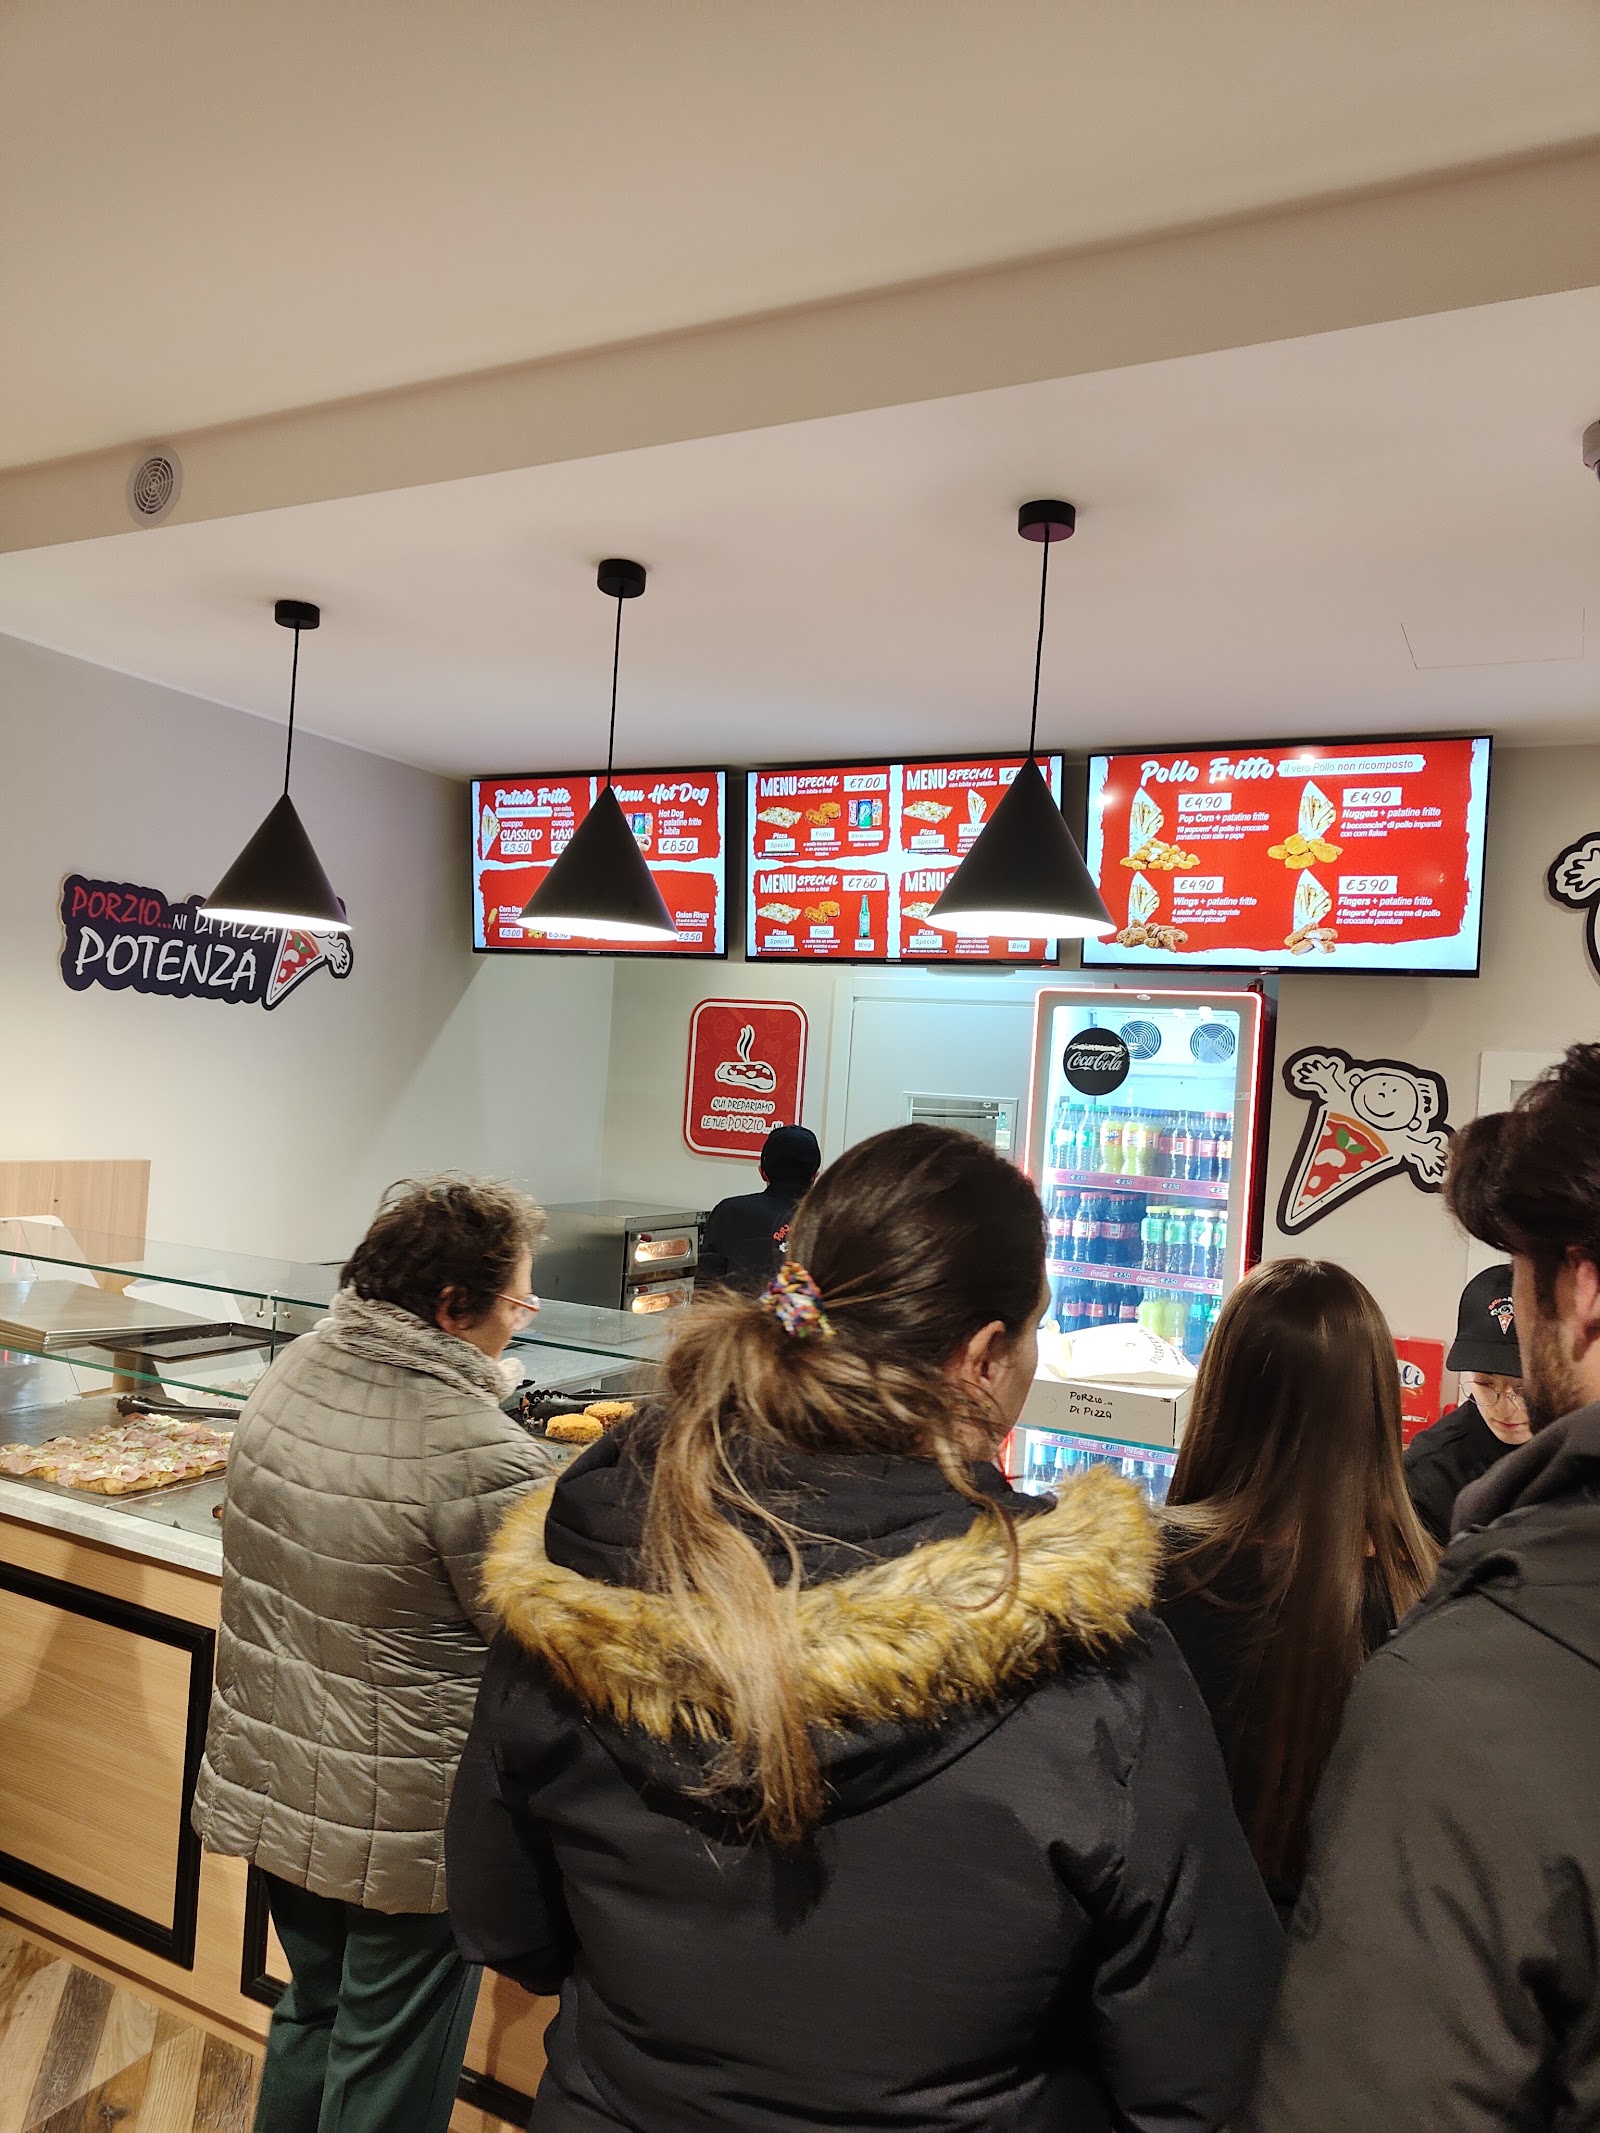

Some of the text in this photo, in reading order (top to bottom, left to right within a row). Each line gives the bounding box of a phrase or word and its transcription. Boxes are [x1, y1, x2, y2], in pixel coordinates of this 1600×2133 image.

[1141, 757, 1274, 787] Pollo Fritto
[1291, 765, 1310, 773] vero
[1313, 762, 1335, 772] Pollo
[1358, 760, 1414, 771] ricomposto
[906, 768, 947, 790] MENU
[948, 768, 994, 780] SPECIAL
[761, 776, 839, 797] MENU SPECIAL
[495, 787, 571, 807] Patate Fritte
[648, 784, 679, 804] Hot
[679, 783, 710, 806] Dog
[658, 809, 684, 818] Hot Dog
[1178, 814, 1194, 825] Pop
[1196, 814, 1214, 823] Corn
[1222, 813, 1250, 823] patatine
[1252, 812, 1269, 821] fritte
[1342, 808, 1378, 819] Nuggets
[1387, 807, 1420, 818] patatine
[1422, 807, 1441, 816] fritte
[1395, 820, 1412, 829] pollo
[500, 829, 543, 841] CLASSICO
[551, 828, 575, 840] MAXI
[760, 874, 838, 893] MENU SPECIAL
[905, 872, 945, 892] MENU
[1174, 897, 1199, 907] Wings
[1207, 897, 1238, 907] patatine
[1239, 896, 1257, 905] fritte
[1338, 896, 1371, 907] Fingers
[1379, 896, 1412, 906] patatine
[1414, 896, 1433, 905] fritte
[693, 911, 709, 920] Rings
[1422, 909, 1441, 918] pollo
[75, 926, 257, 991] POTENZA
[713, 1098, 774, 1112] QUI PREPARIAMO
[703, 1117, 711, 1127] LE
[713, 1118, 725, 1128] TUE
